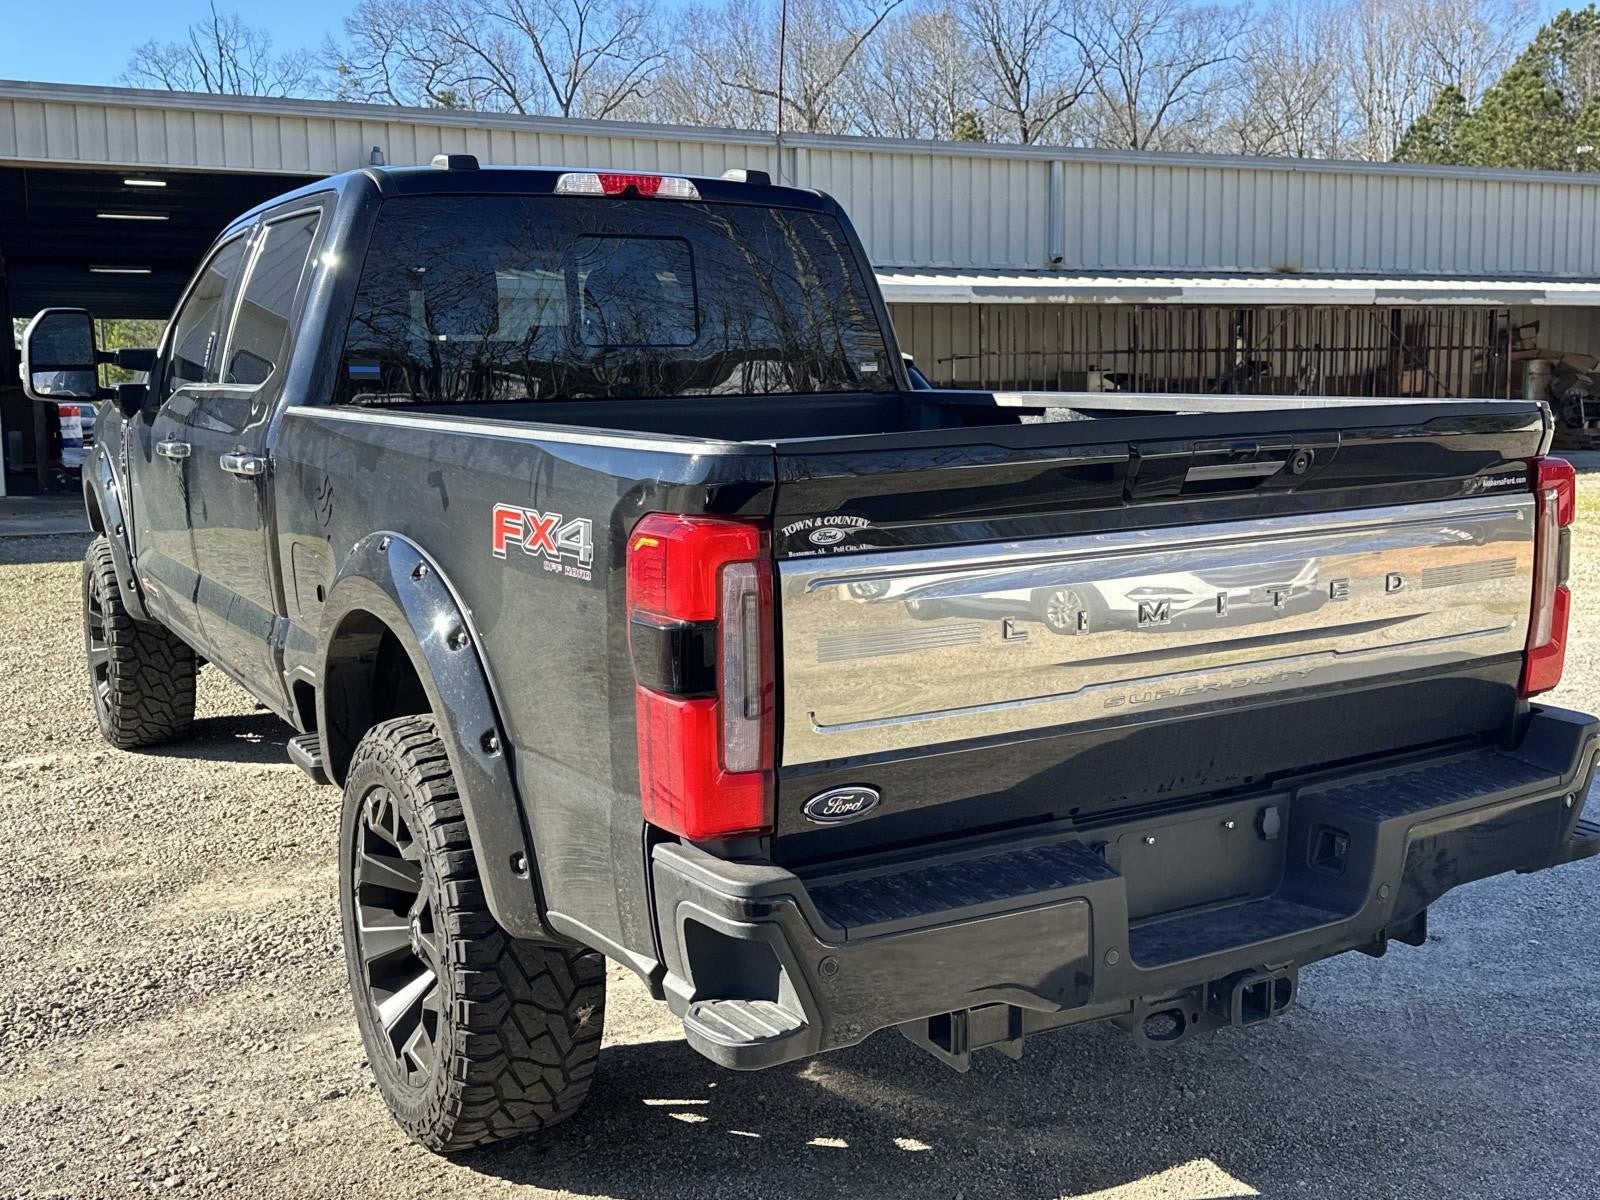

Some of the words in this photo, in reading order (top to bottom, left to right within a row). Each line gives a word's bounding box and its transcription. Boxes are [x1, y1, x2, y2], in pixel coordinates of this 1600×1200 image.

[492, 502, 594, 570] FX4
[781, 518, 813, 537] TOWN
[814, 517, 823, 527] &
[823, 515, 871, 529] COUNTRY
[1001, 571, 1406, 642] LIMITED
[1103, 681, 1222, 709] SUPER
[1230, 666, 1316, 690] DUTY
[823, 794, 864, 815] Ford
